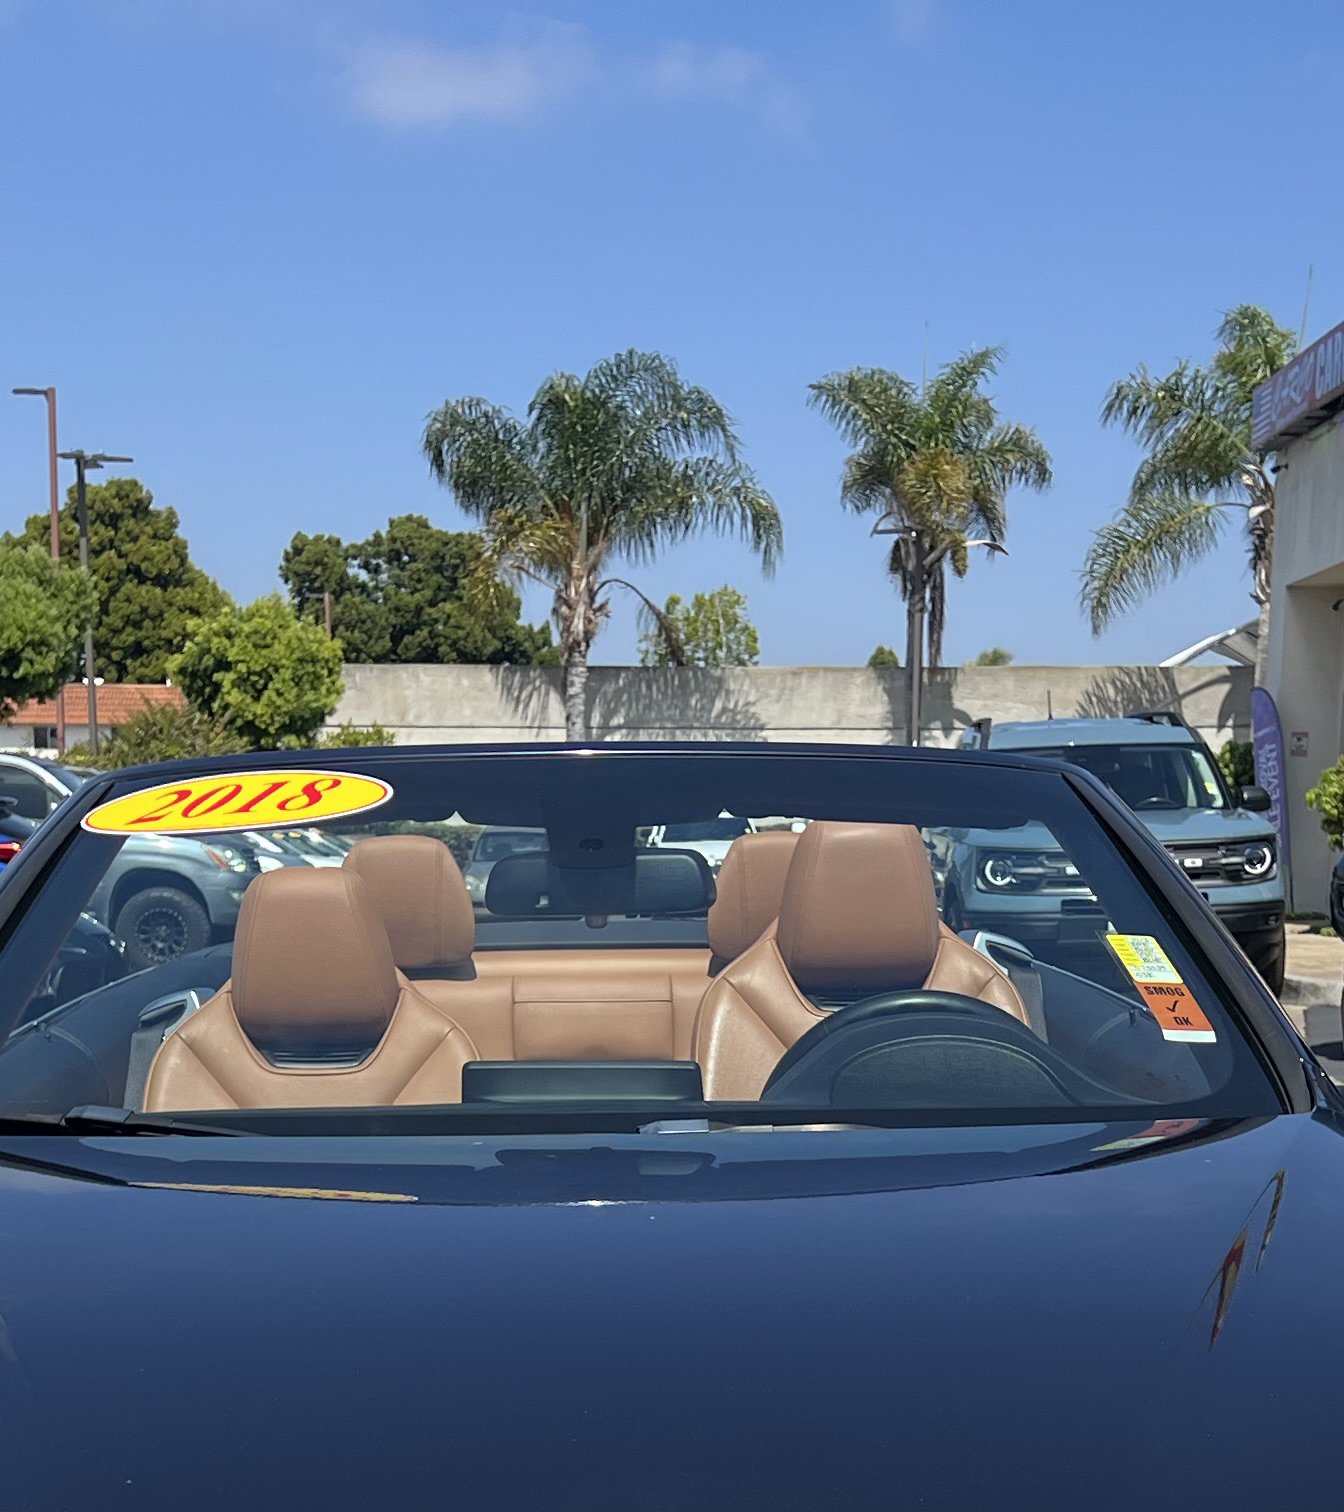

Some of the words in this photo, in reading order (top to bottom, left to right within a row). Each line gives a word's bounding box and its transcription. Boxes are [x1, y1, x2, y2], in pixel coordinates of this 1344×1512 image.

[123, 778, 343, 826] 2018
[1144, 985, 1186, 997] SMOG
[1173, 1016, 1193, 1026] OK
